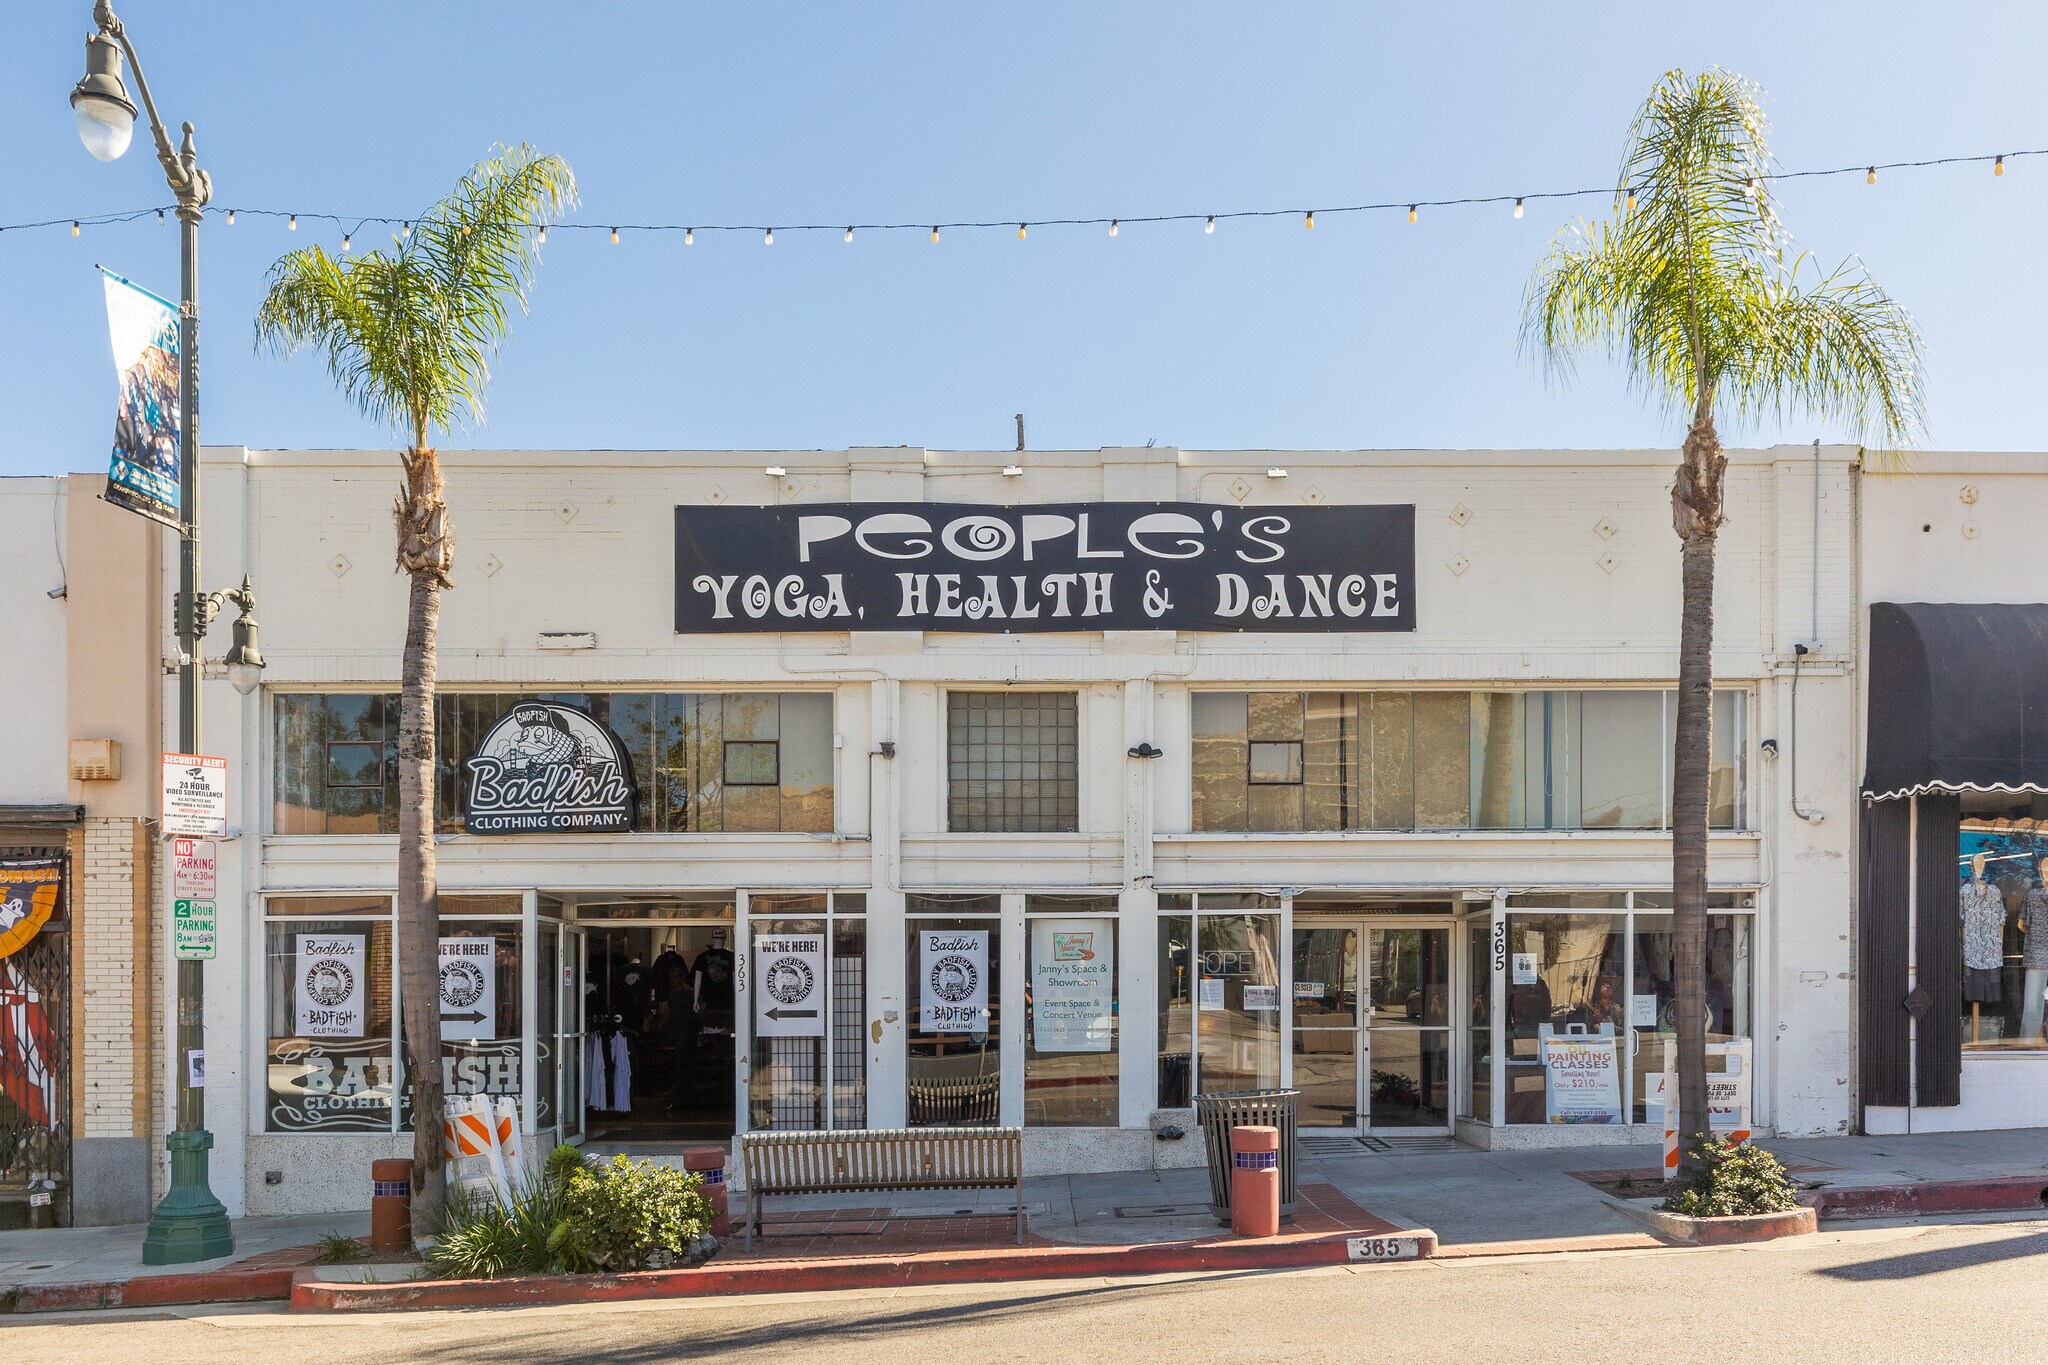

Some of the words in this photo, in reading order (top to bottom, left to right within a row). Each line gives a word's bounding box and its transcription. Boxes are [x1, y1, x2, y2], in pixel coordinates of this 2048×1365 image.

[798, 510, 1291, 563] PEOPLE'S
[894, 572, 1114, 619] HEALTH
[1142, 569, 1174, 618] &
[1213, 572, 1399, 619] DANCE
[516, 710, 549, 724] BADFISH
[164, 754, 201, 766] SECURITY
[202, 758, 225, 768] ALERT
[180, 781, 188, 789] 24
[190, 782, 210, 790] HOUR
[467, 756, 629, 813] Badfish
[184, 790, 223, 798] SURVEILLANCE
[475, 816, 548, 829] CLOTHING
[551, 814, 622, 827] COMPANY
[176, 842, 190, 855] NO
[176, 858, 214, 870] PARKING
[0, 867, 59, 884] oween
[176, 870, 187, 879] 4AM
[193, 872, 214, 880] 6:30AM
[178, 902, 187, 915] 2
[192, 907, 213, 916] HOUR
[177, 920, 214, 931] PARKING
[177, 933, 192, 942] 8AM
[929, 936, 979, 952] Badfish
[306, 940, 355, 956] Badfish
[462, 944, 489, 956] HERE!
[762, 941, 790, 952] WE'RE
[792, 940, 818, 952] HERE!
[1494, 922, 1504, 971] 365
[314, 960, 346, 972] BADFISH
[444, 961, 476, 973] BADFISH
[773, 958, 806, 970] BADFISH
[938, 956, 971, 967] BADFISH
[1206, 952, 1253, 973] OPE
[738, 954, 746, 992] 363
[1038, 964, 1069, 976] Janny's
[1072, 964, 1097, 975] Space
[1100, 964, 1108, 973] &
[307, 973, 328, 1005] COMPANY
[331, 972, 353, 1005] CLOTHING
[462, 972, 483, 1006] CLOTHING
[768, 970, 789, 1003] COMPANY
[791, 969, 813, 1003] CLOTHING
[932, 967, 953, 1001] COMPANY
[955, 968, 977, 1001] CLOTHING
[1048, 978, 1098, 987] Showroom
[1295, 983, 1312, 992] CLOSED
[1068, 1000, 1092, 1009] Space
[1094, 999, 1100, 1007] &
[1042, 1011, 1075, 1019] Concert
[1076, 1011, 1102, 1019] Venue
[1548, 1053, 1611, 1061] PAINTING
[1568, 1046, 1590, 1054] OIL
[1551, 1061, 1609, 1069] CLASSES
[303, 1056, 520, 1096] BADISH
[304, 1096, 410, 1110] CLOTHING
[1360, 1238, 1400, 1256] 365
